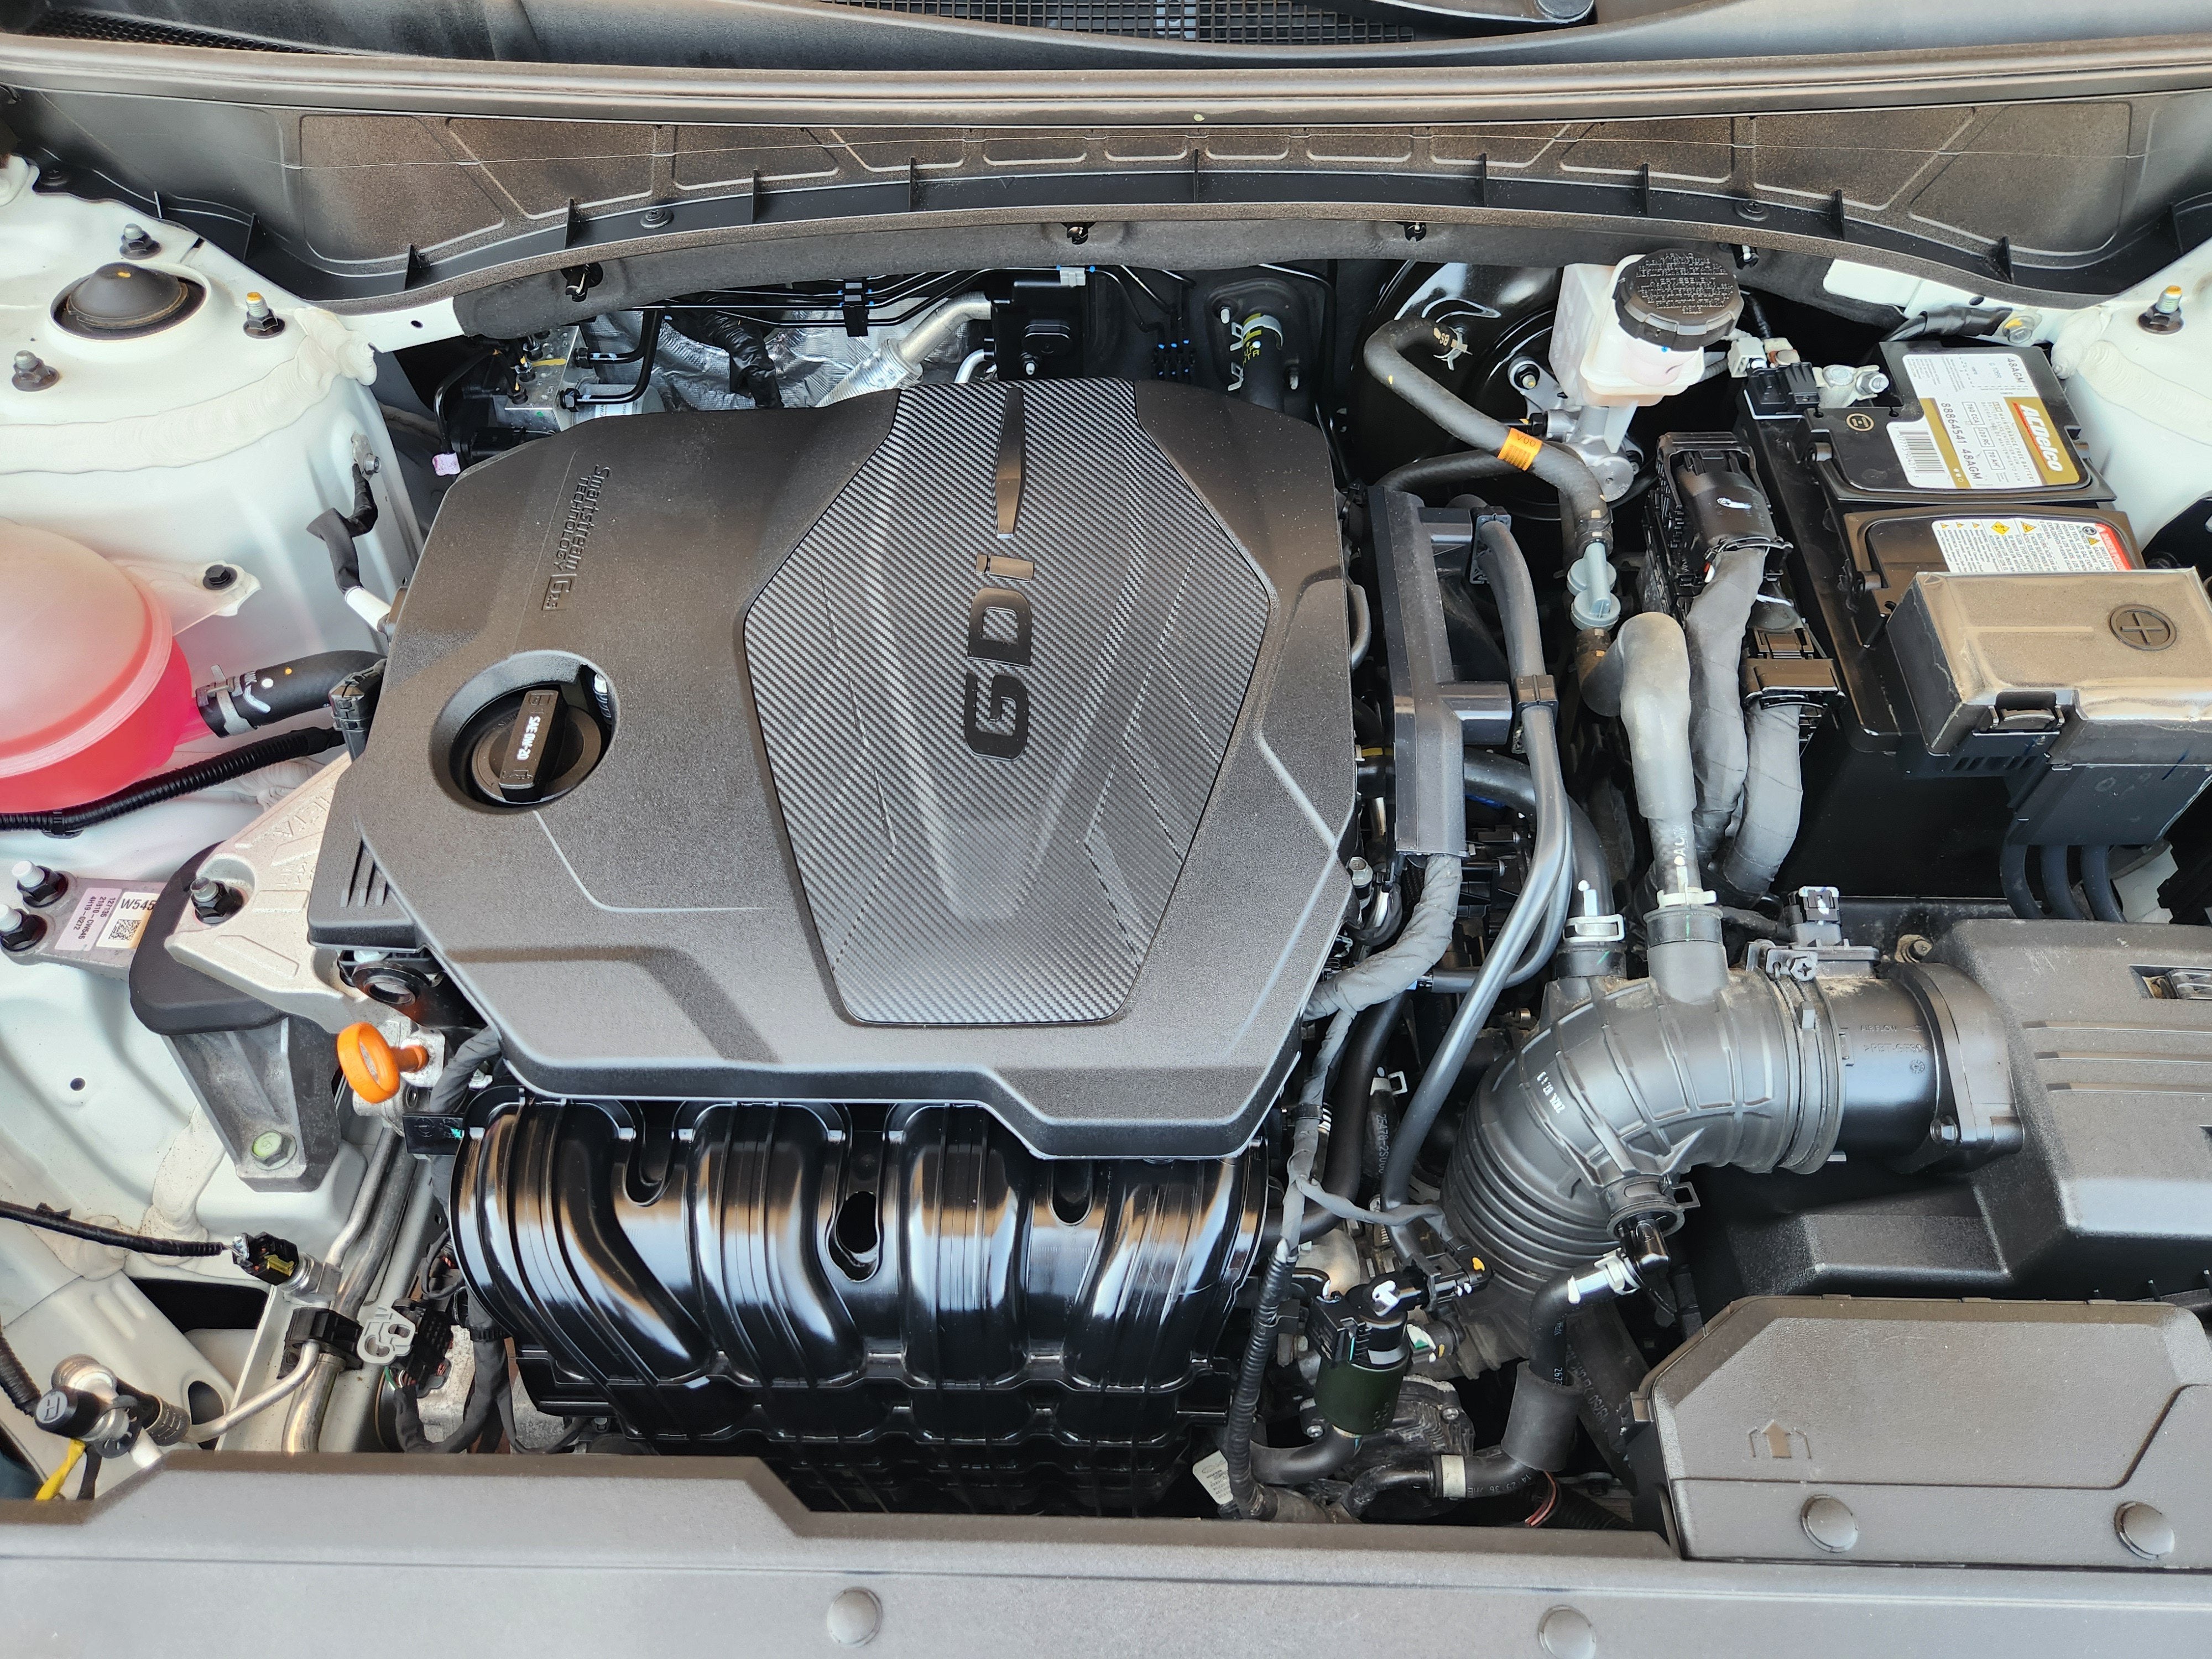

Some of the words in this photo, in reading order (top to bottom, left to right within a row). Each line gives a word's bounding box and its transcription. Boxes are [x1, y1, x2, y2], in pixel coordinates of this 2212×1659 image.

[2005, 358, 2026, 383] 48AGM
[1970, 414, 1980, 423] CCA
[1940, 403, 1967, 444] 88864541
[1960, 448, 1983, 479] 48AGM
[2019, 404, 2063, 471] ACDelco
[2021, 461, 2036, 483] BATTERY
[554, 475, 591, 571] TECHNOLOGY
[964, 554, 1035, 761] GDi
[525, 716, 541, 734] SAE
[100, 897, 116, 917] 127135
[121, 898, 158, 911] W545
